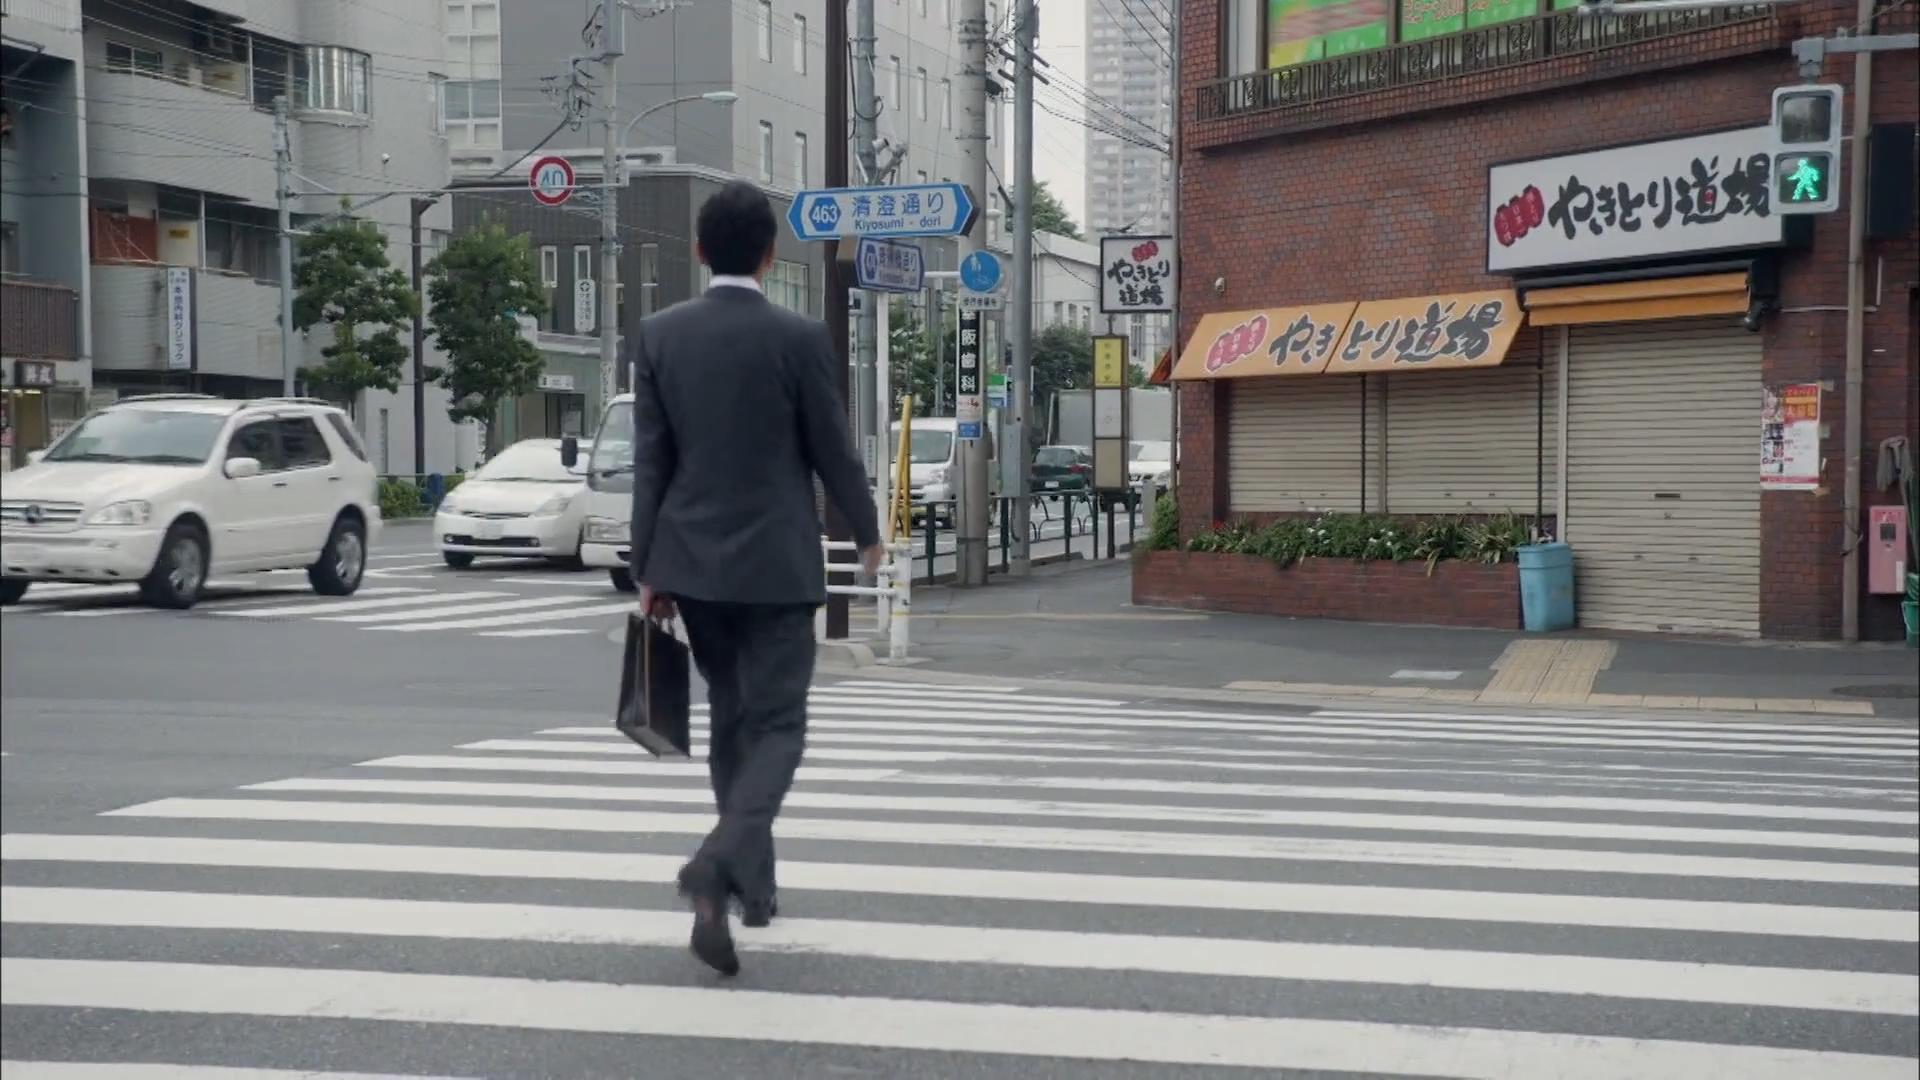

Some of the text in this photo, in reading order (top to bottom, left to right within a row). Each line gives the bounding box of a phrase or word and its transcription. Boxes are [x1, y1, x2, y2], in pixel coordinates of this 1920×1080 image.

[851, 192, 944, 217] 清澄通り
[1547, 152, 1771, 240] やきとり道場
[811, 205, 838, 224] 463
[855, 218, 904, 231] Kiyosumi
[919, 216, 941, 227] dori
[1107, 258, 1170, 284] やきとり
[1119, 283, 1164, 306] 道場
[1268, 300, 1504, 366] やきとり道場
